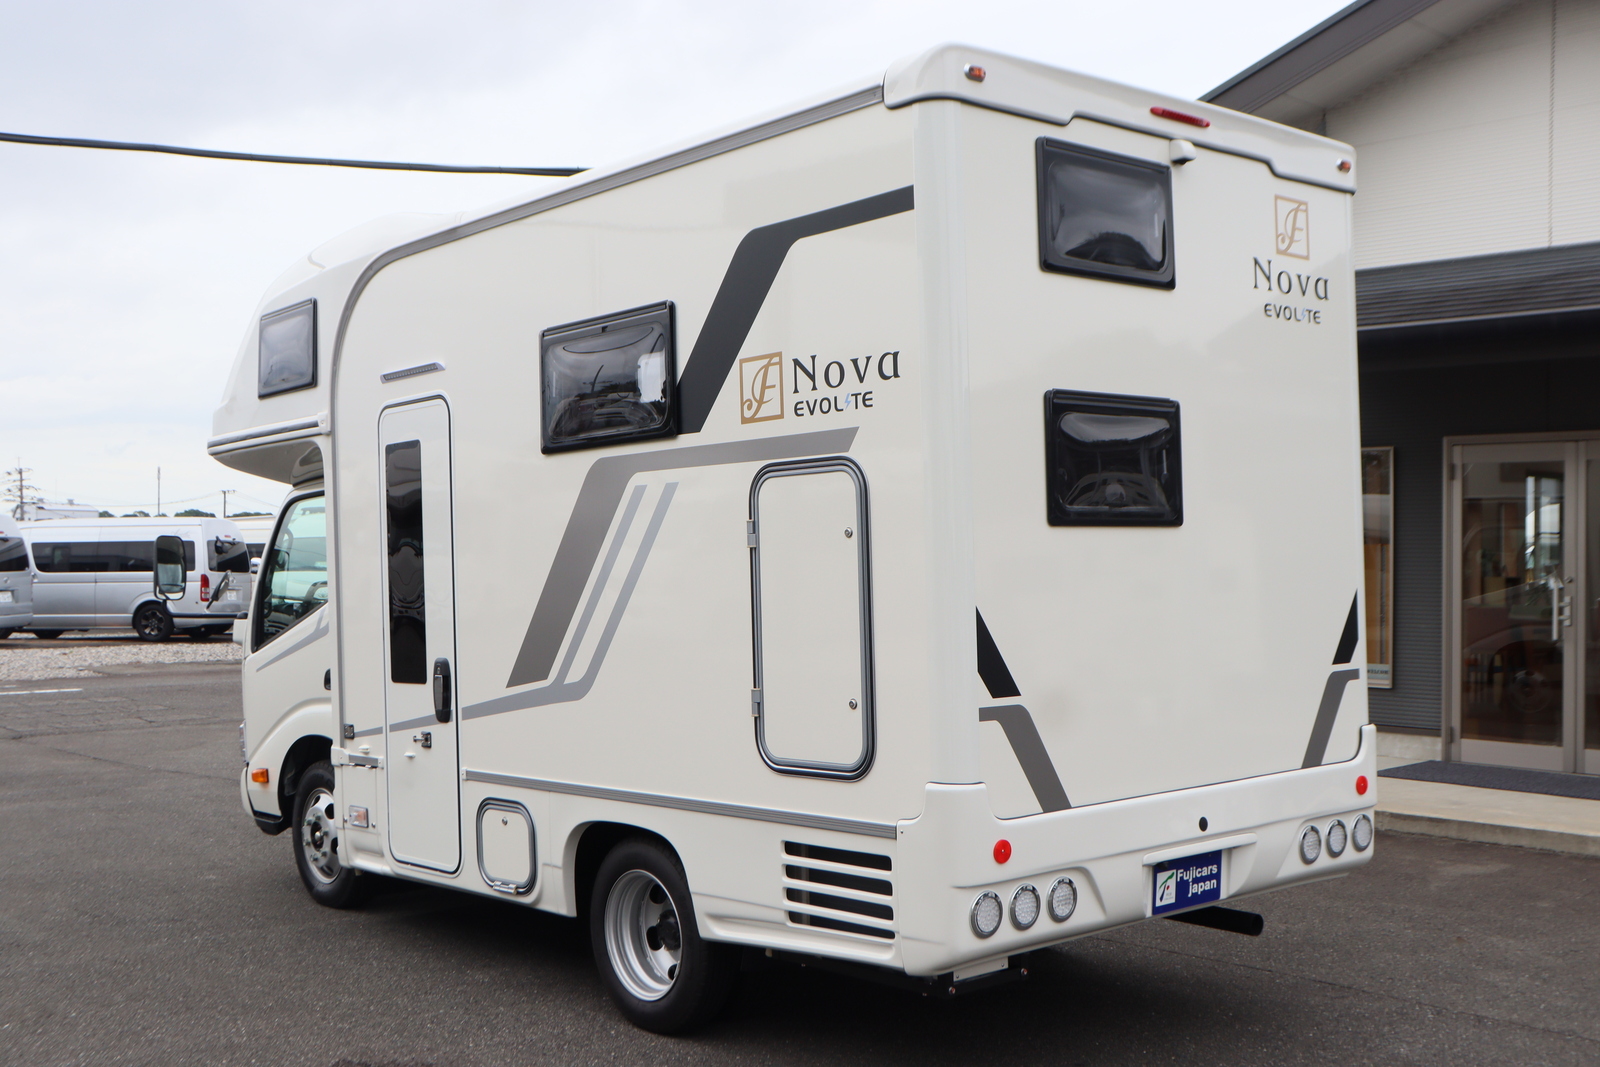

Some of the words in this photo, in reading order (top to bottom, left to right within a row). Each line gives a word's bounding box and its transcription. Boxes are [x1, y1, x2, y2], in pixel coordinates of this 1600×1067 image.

[1253, 256, 1329, 301] Nova
[792, 351, 901, 394] Nova
[1177, 864, 1218, 882] Fujicars
[1188, 879, 1217, 897] japan
